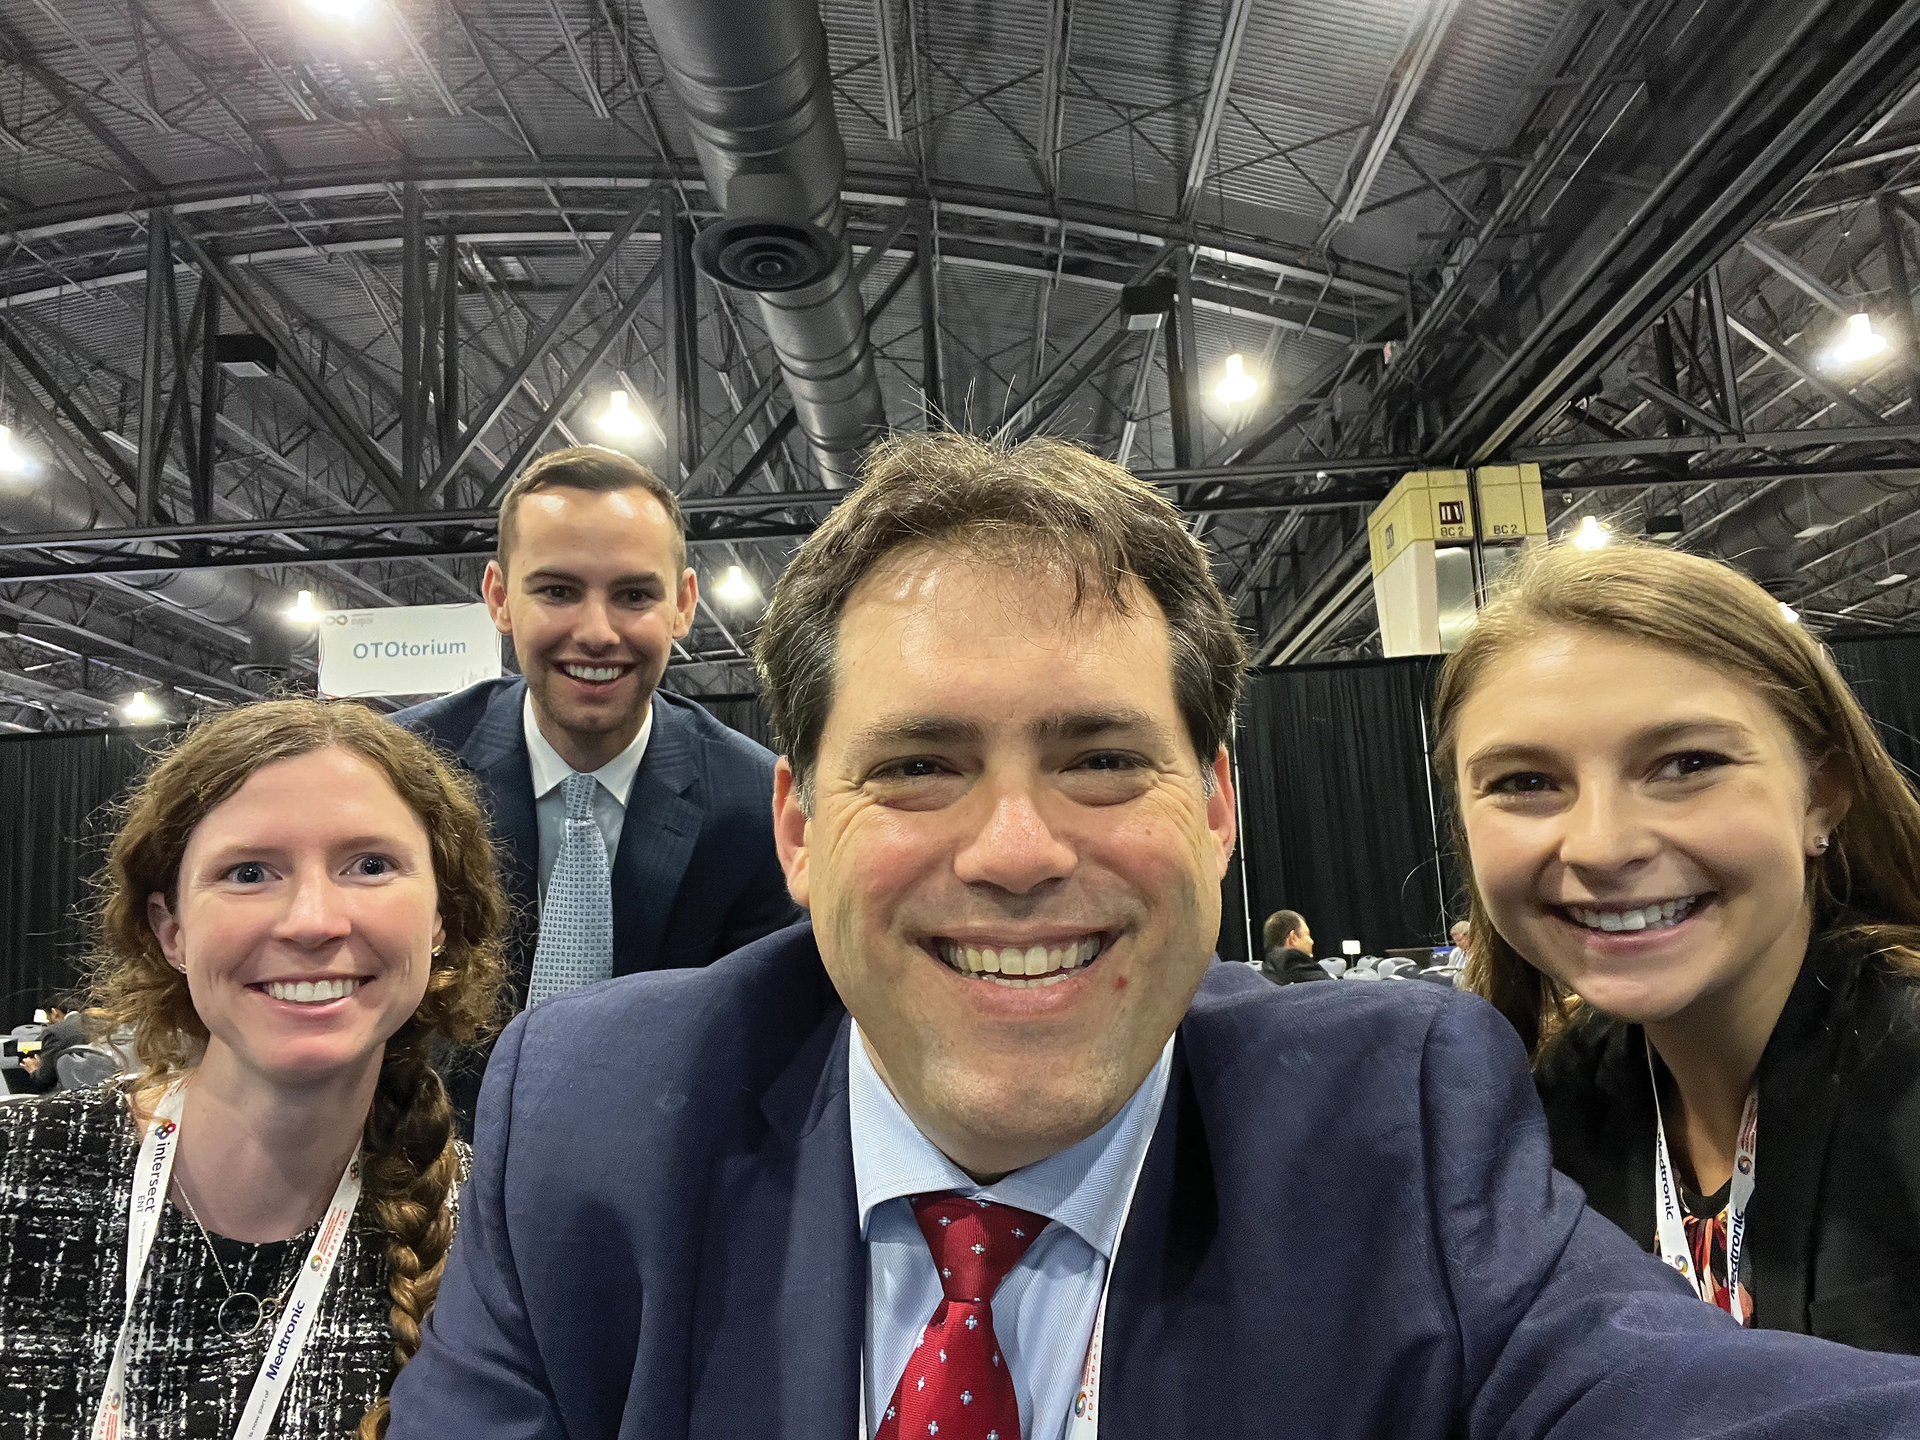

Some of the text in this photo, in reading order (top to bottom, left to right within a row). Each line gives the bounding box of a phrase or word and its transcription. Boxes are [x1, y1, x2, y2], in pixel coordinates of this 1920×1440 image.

[1441, 526, 1464, 536] BC 2
[1493, 524, 1518, 535] BC 2
[352, 639, 467, 660] OTOtorium
[144, 1142, 170, 1213] intersect
[1657, 1132, 1674, 1221] Medtronic
[136, 1195, 146, 1213] ENT
[1730, 1208, 1745, 1300] Medtronic
[266, 1299, 306, 1381] Medtronic
